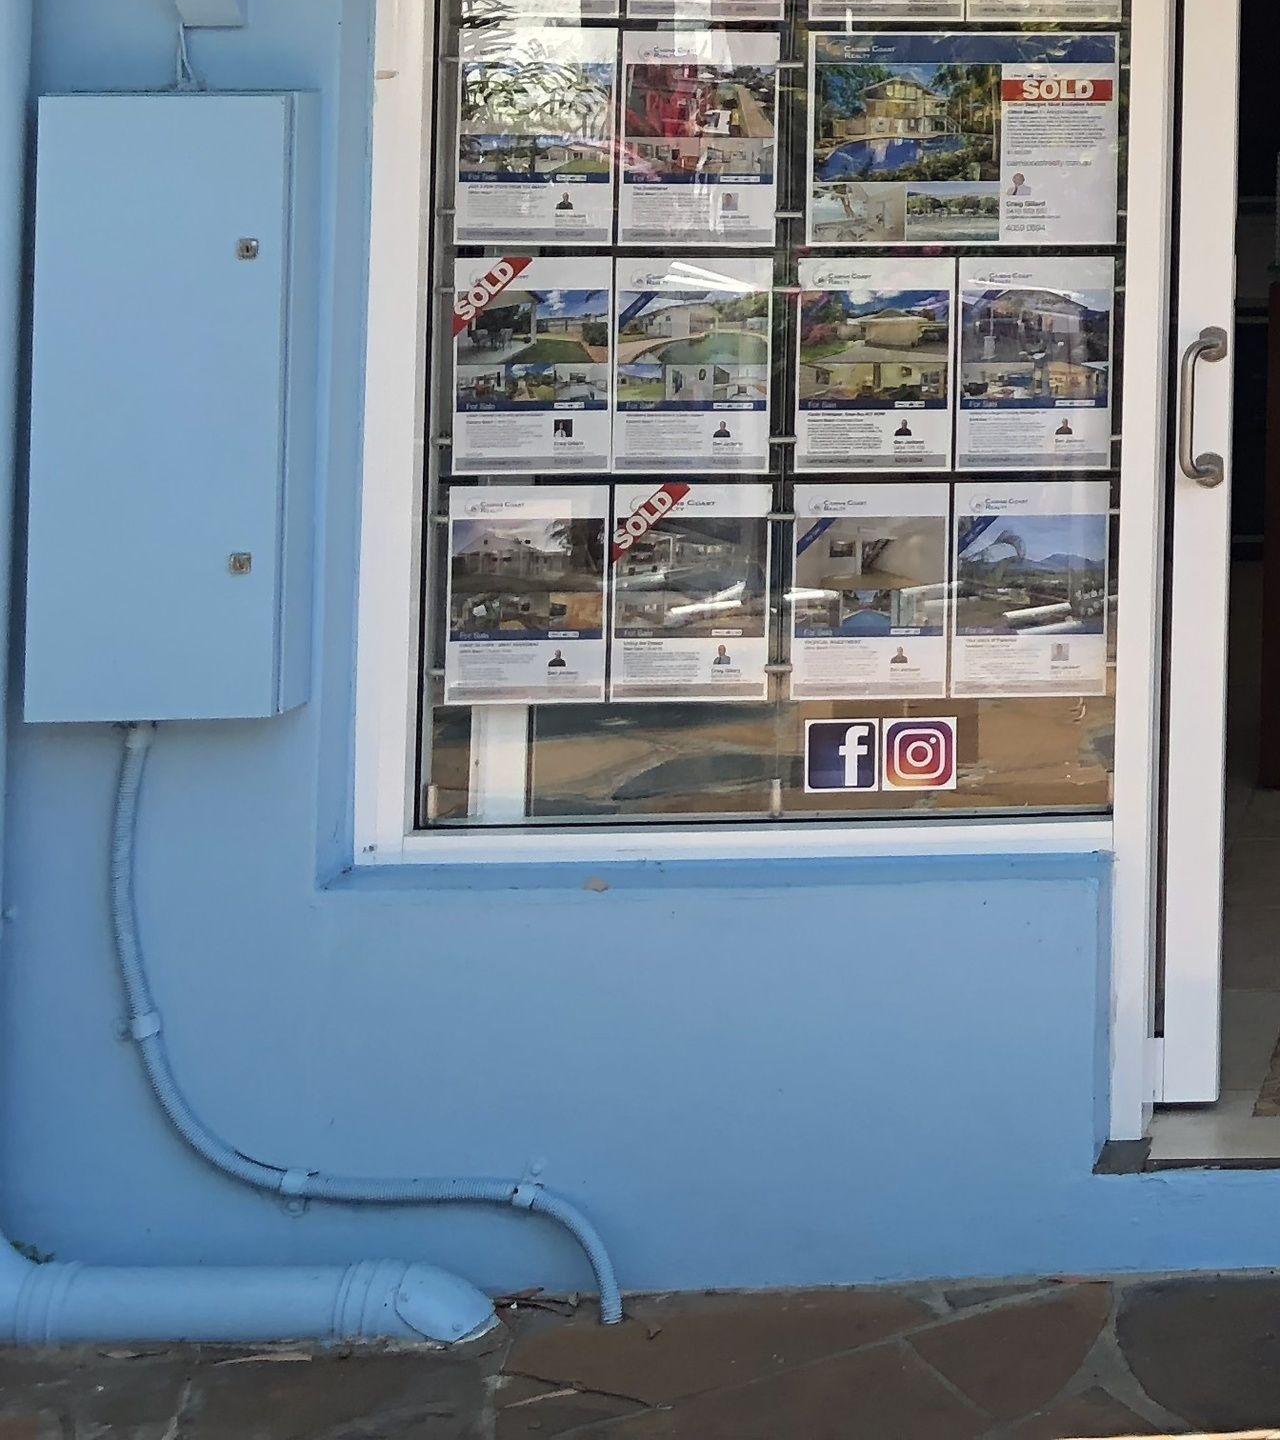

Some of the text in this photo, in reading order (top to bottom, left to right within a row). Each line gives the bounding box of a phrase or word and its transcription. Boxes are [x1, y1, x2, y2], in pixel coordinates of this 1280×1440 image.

[1022, 79, 1095, 100] SOLD
[454, 260, 515, 321] SOLD
[613, 490, 673, 550] SOLD
